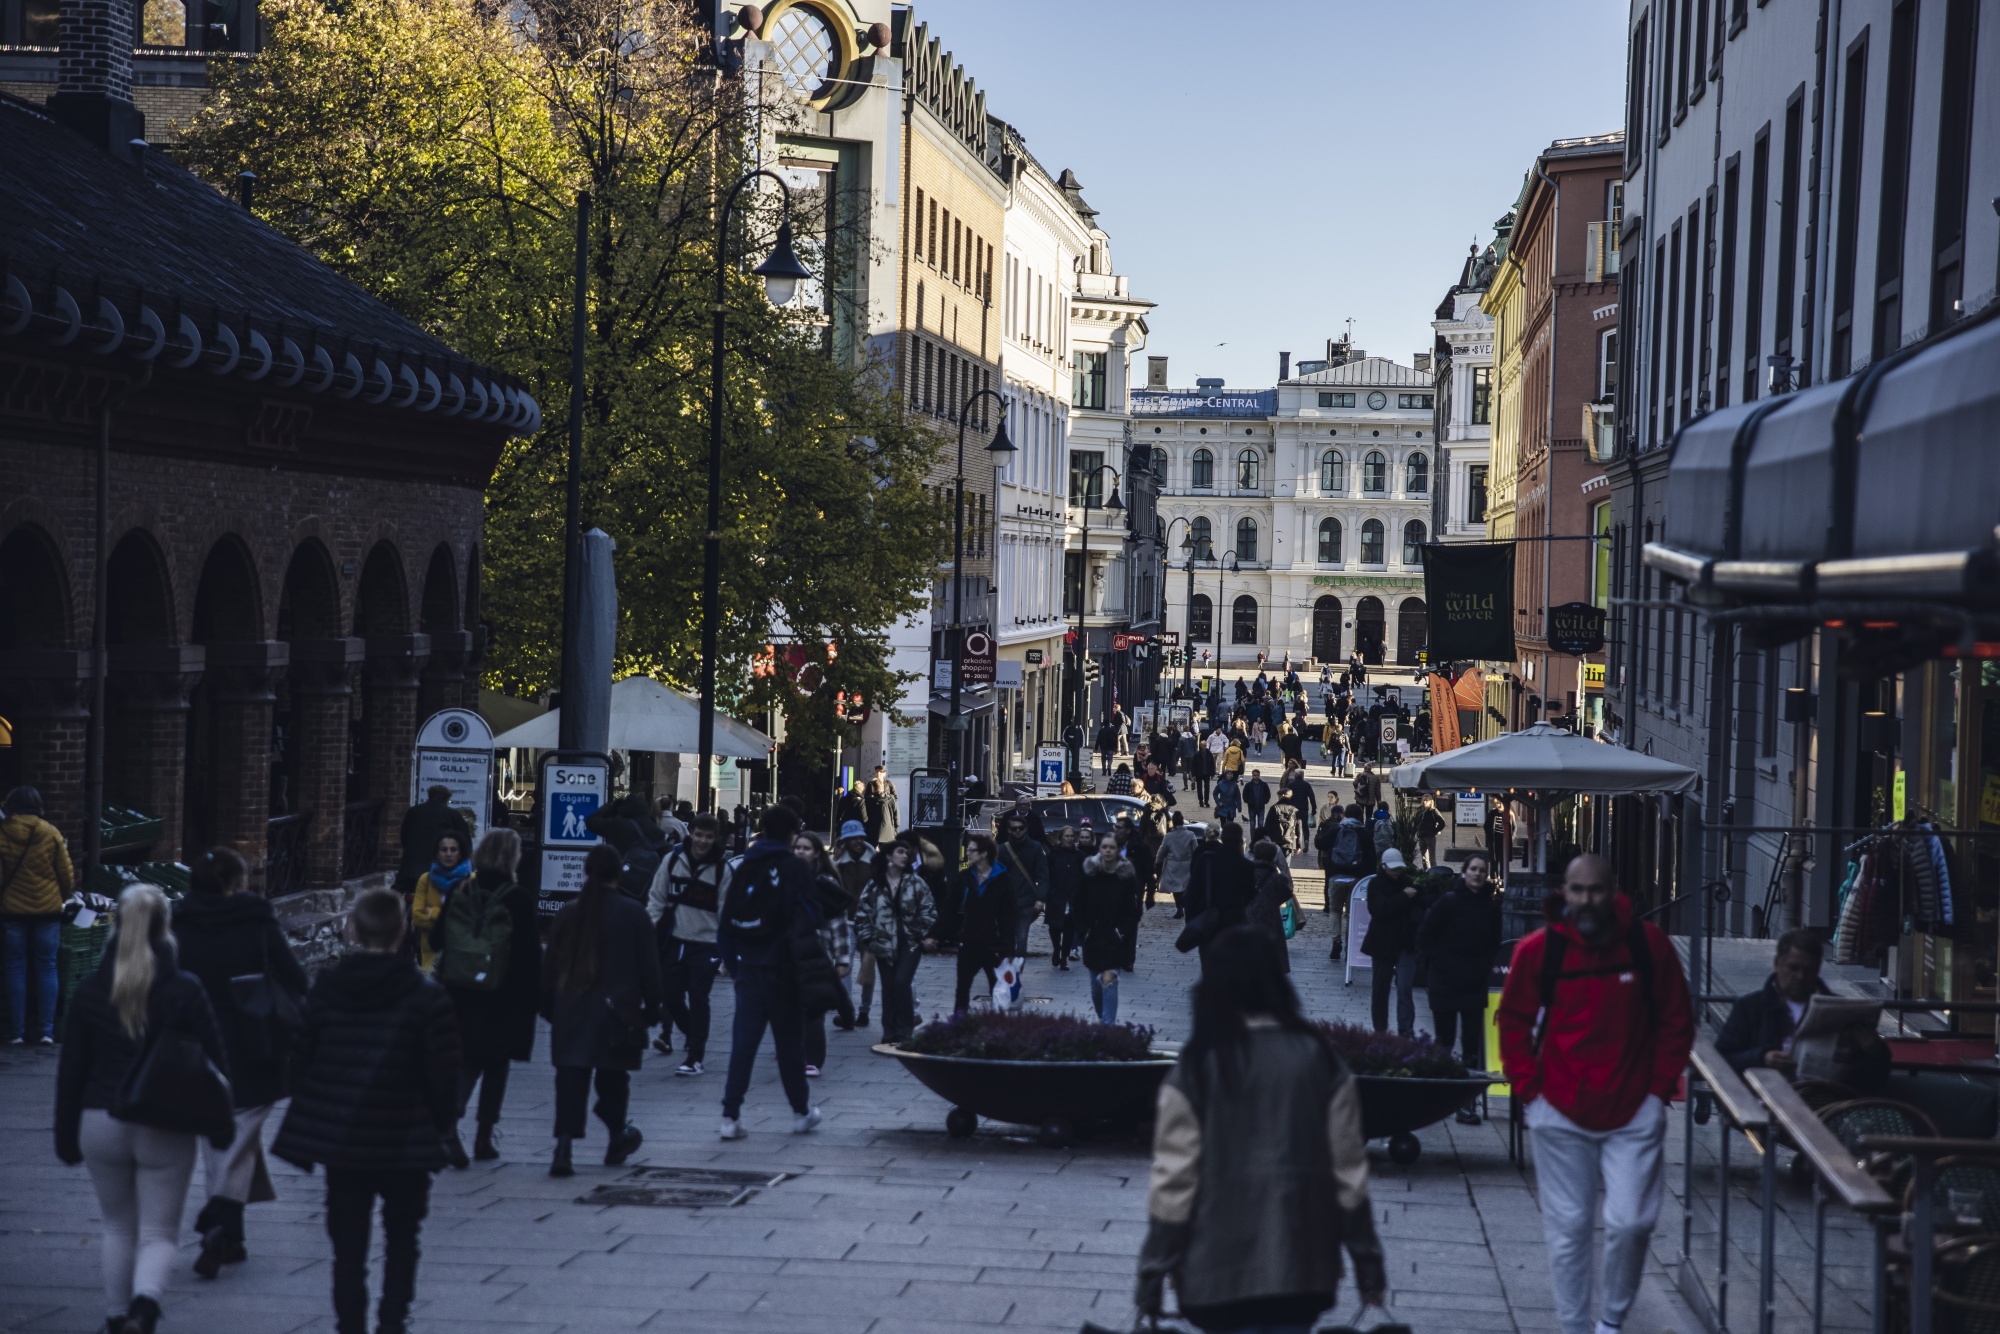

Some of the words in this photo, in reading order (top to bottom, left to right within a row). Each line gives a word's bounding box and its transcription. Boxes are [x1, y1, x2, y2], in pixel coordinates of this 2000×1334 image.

[1130, 396, 1156, 406] OTEL
[1160, 395, 1203, 407] GRAND
[1207, 396, 1259, 408] CENTRAL
[1314, 576, 1425, 587] ØSTBANEHALLEN
[1116, 637, 1126, 647] deli
[1136, 645, 1148, 657] N
[961, 665, 993, 673] shopping
[1385, 730, 1393, 738] 30
[1042, 749, 1061, 758] Sone
[452, 756, 488, 764] GAMMELT
[439, 764, 470, 773] GULL?
[556, 769, 596, 785] Sone
[559, 793, 592, 805] Gågate
[548, 853, 589, 863] Varetransp
[562, 862, 583, 871] tillatt
[537, 899, 567, 911] ATHED
